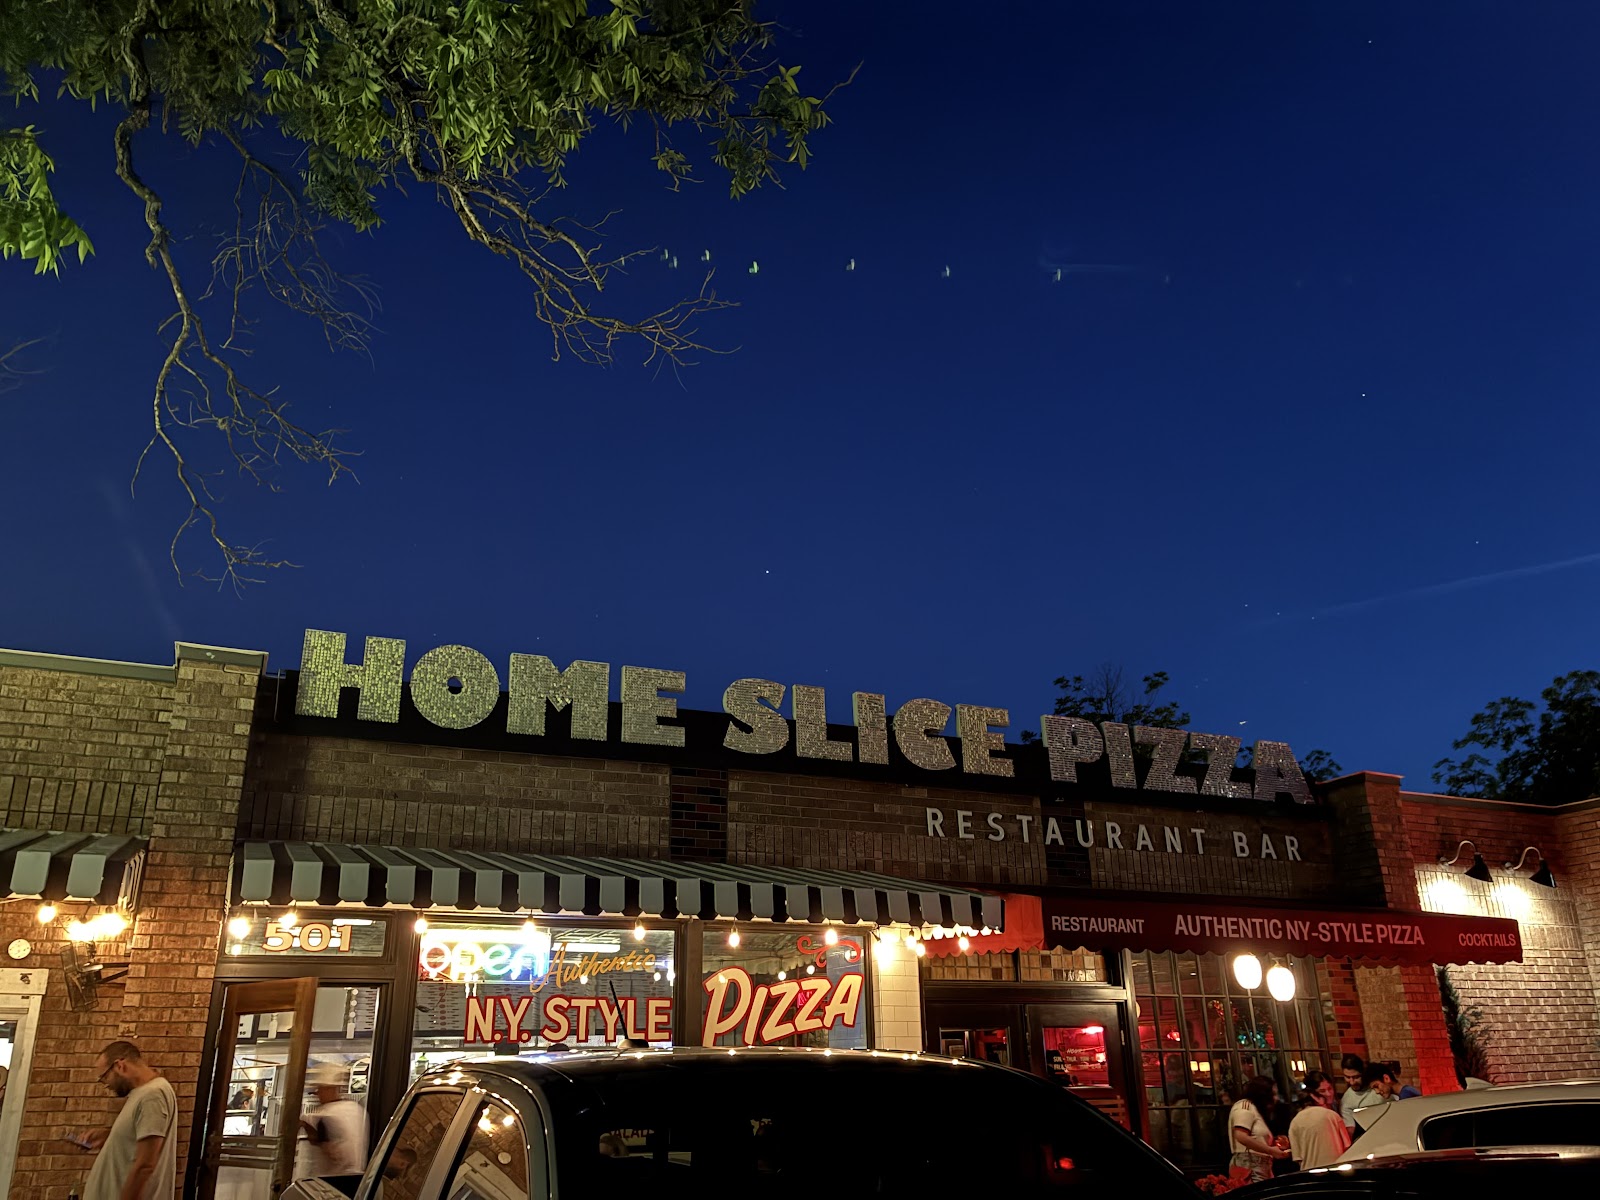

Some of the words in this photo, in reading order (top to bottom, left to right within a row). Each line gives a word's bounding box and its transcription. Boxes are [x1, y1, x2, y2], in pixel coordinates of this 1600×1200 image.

[295, 628, 686, 747] HOME
[722, 677, 1015, 778] SLICE
[1040, 713, 1315, 805] PIZZA
[926, 807, 1205, 854] RESTAURANT
[1233, 831, 1302, 861] BAR
[261, 921, 353, 952] 501
[1052, 915, 1145, 934] RESTAURANT
[1174, 914, 1283, 940] AUTHENTIC
[1286, 920, 1373, 944] NY-STYLE
[1376, 924, 1425, 946] PIZZA
[1458, 932, 1517, 948] COCKTAILS
[529, 942, 656, 993] Authentic
[464, 996, 534, 1043] N.Y.
[542, 994, 673, 1043] STYLE
[702, 965, 864, 1048] PIZZA
